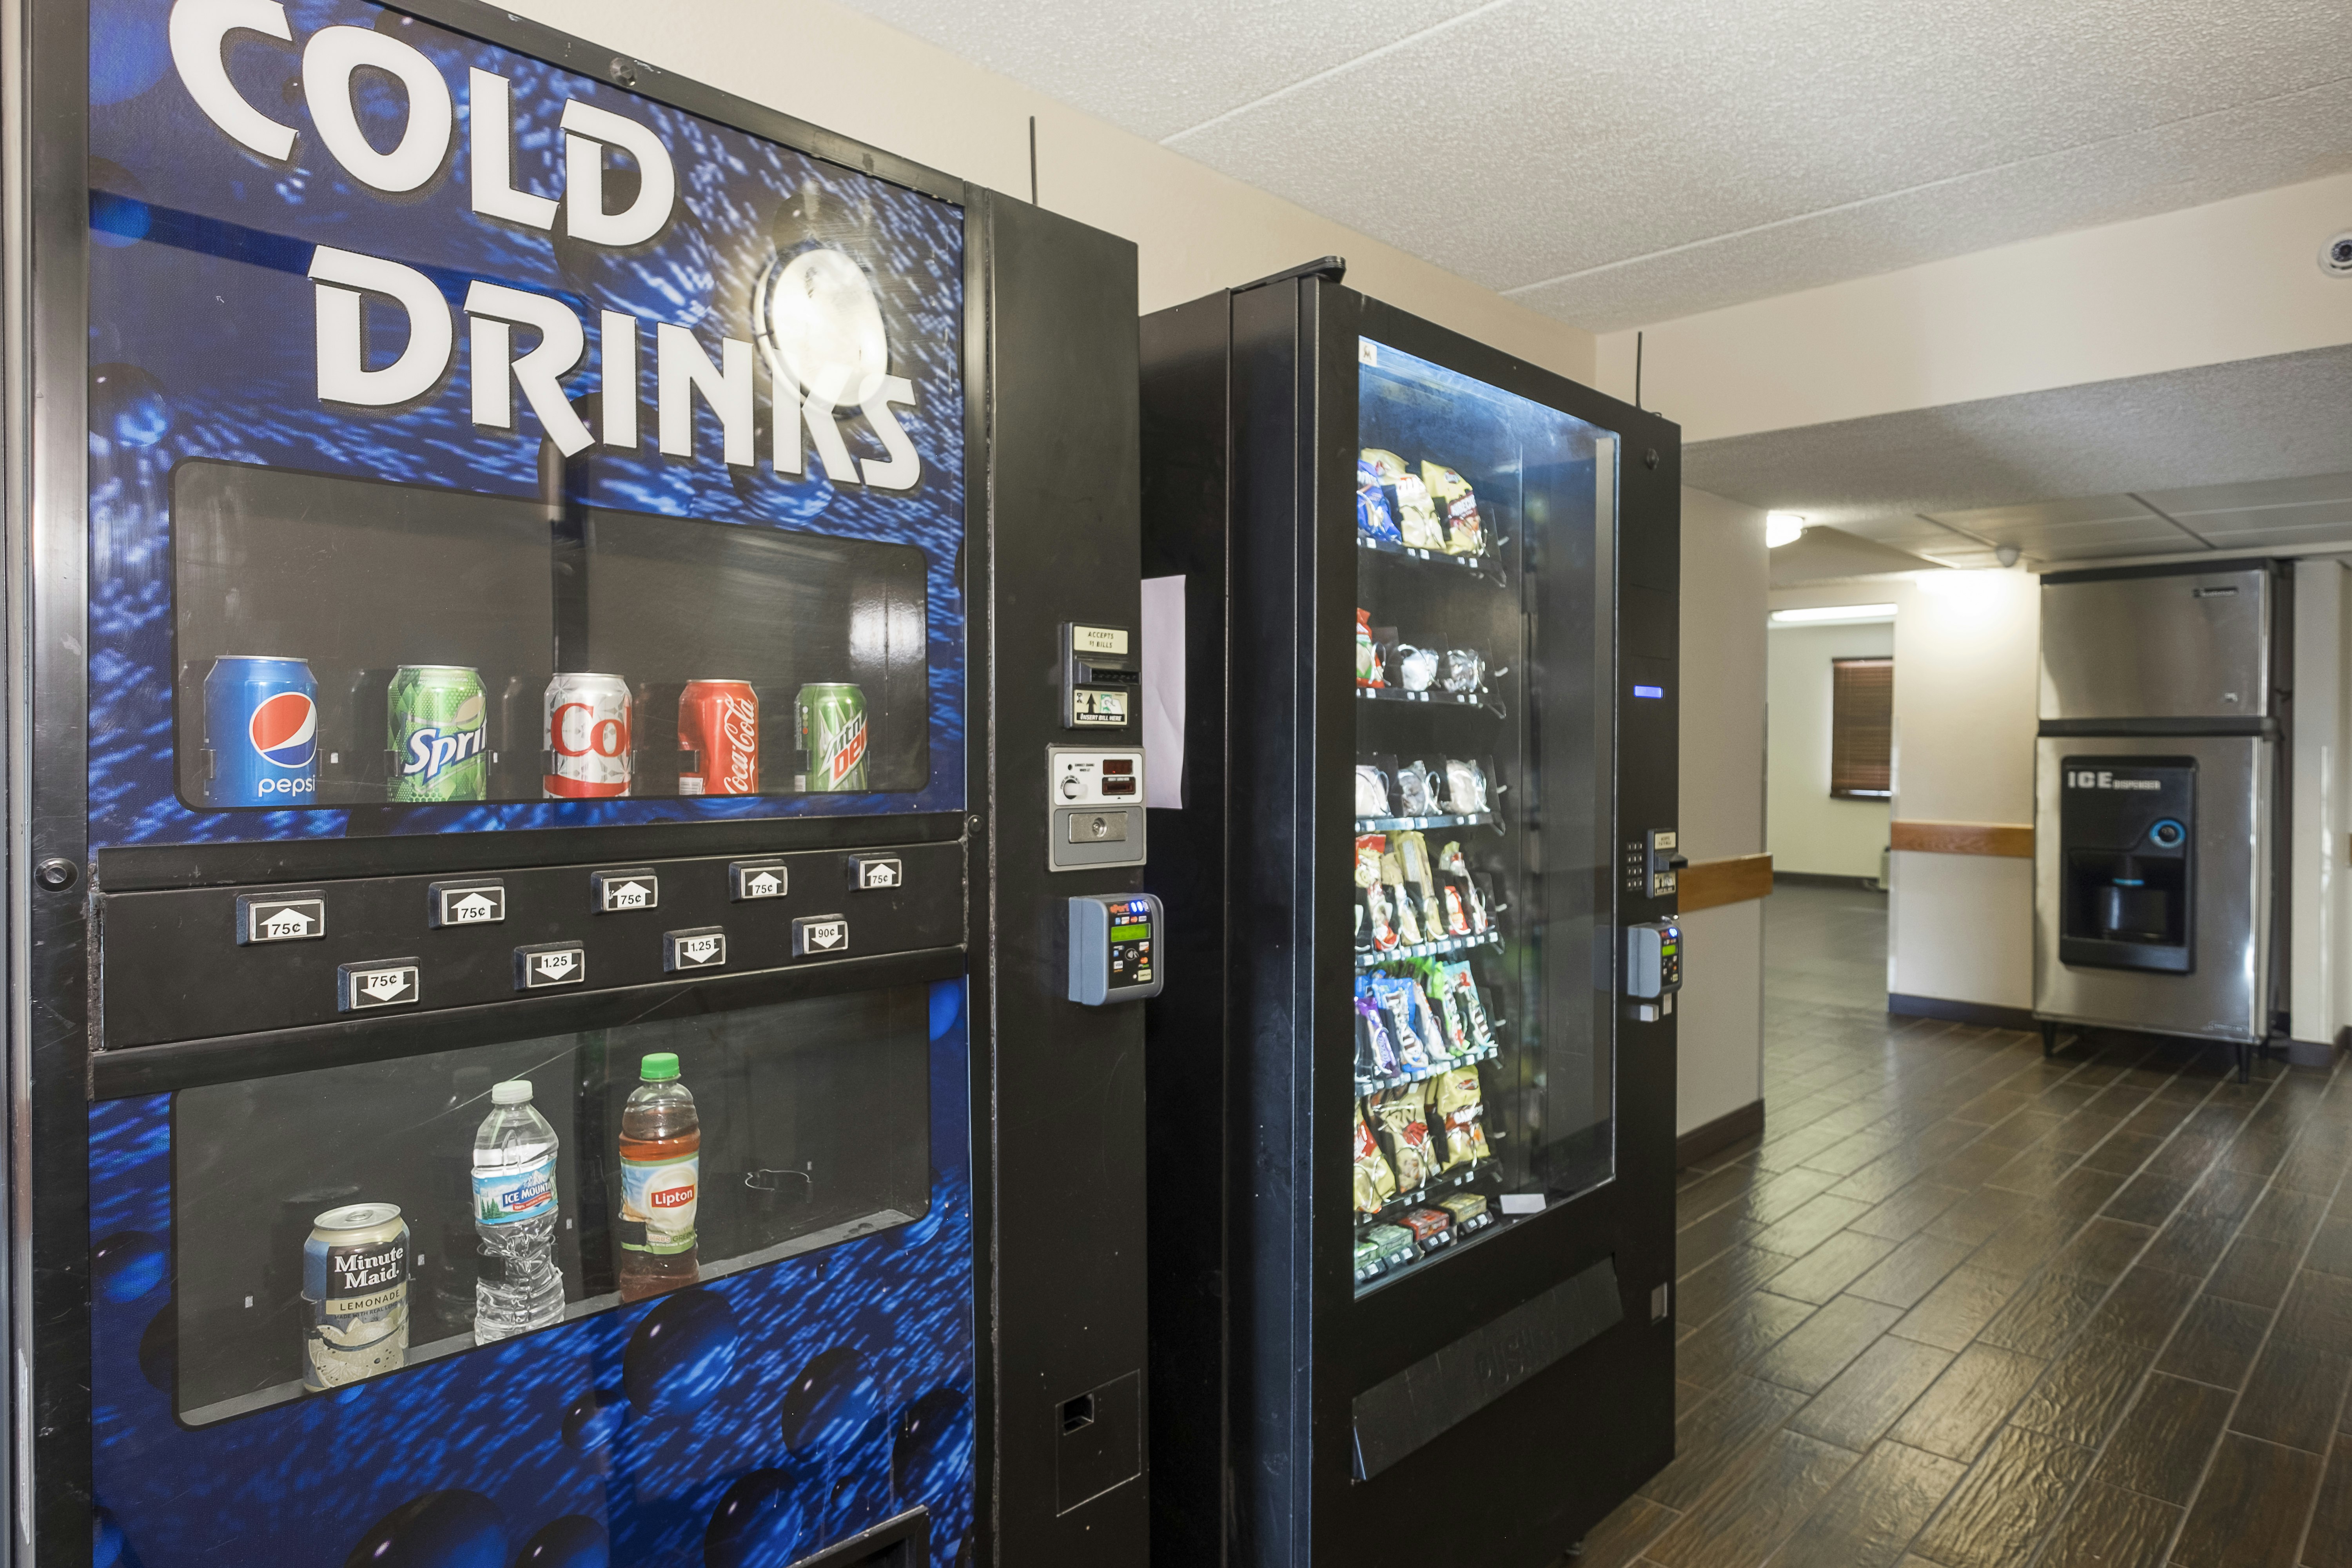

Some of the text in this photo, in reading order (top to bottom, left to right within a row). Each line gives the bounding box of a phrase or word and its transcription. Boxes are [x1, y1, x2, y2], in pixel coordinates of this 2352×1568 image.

[169, 0, 675, 247] COLD
[308, 245, 920, 490] DRINKS
[827, 717, 860, 764] Mtn
[258, 774, 315, 797] pepsi
[2068, 771, 2113, 789] ICE
[873, 875, 887, 884] 75¢
[755, 884, 773, 893] 75¢
[621, 894, 641, 904] 75¢
[461, 906, 485, 918] 75¢
[272, 922, 301, 935] 75¢
[818, 928, 835, 938] 90¢
[691, 940, 711, 952] 1.25
[544, 955, 568, 968] 1.25
[370, 975, 397, 987] 75¢
[505, 1192, 520, 1204] ICE
[655, 1189, 693, 1206] Lipton
[334, 1247, 403, 1272] Minute
[340, 1289, 400, 1311] LEMONADE
